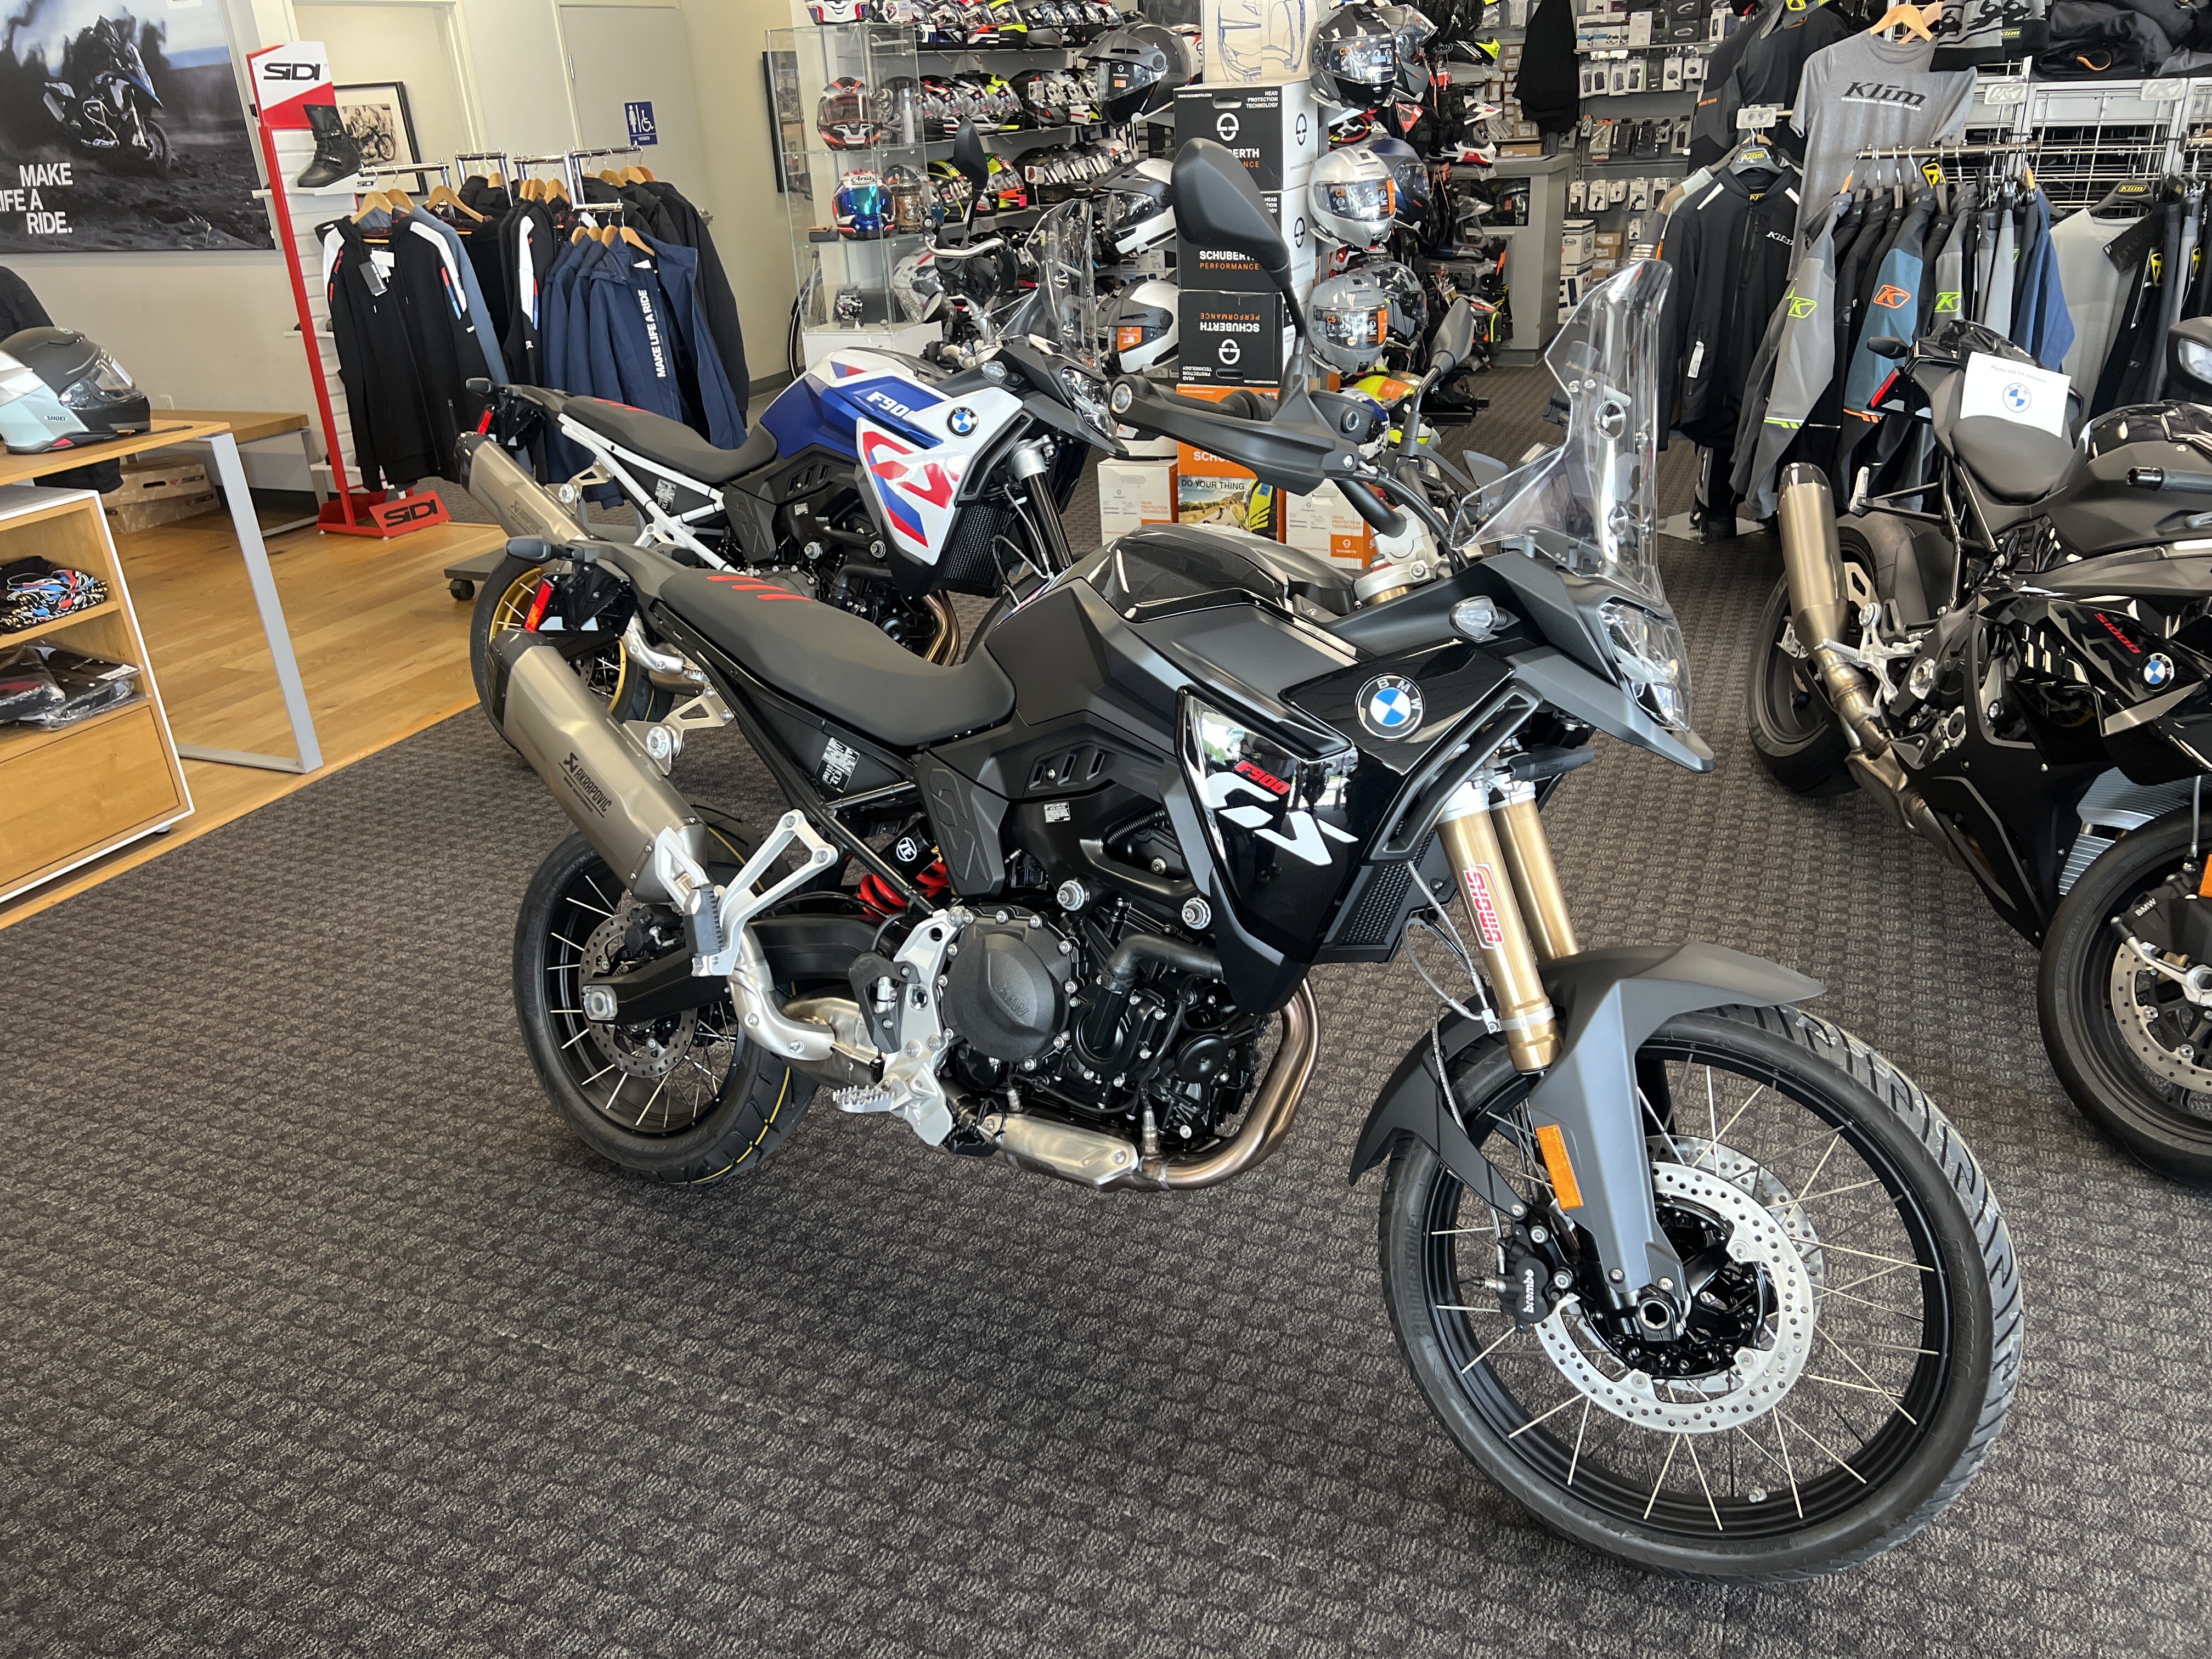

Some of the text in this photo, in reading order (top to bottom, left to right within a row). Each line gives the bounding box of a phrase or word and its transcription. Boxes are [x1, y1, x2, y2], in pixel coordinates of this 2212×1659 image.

[263, 63, 320, 81] SIDI
[19, 162, 74, 187] MAKE
[0, 188, 44, 212] IFE A
[26, 211, 73, 234] RIDE.
[1199, 250, 1255, 261] SCHUBER
[1200, 262, 1259, 270] PERFORMANCE
[1200, 312, 1260, 320] PERFORMANCE
[1200, 321, 1260, 332] SCHUBERTH
[637, 289, 667, 377] MAKE LIFE A RIDE
[1181, 479, 1193, 487] DO
[1195, 480, 1217, 488] YOUR
[1219, 481, 1247, 490] THING.
[384, 499, 438, 528] SIDI
[2094, 613, 2141, 654] S1000
[1234, 759, 1291, 795] F900
[896, 837, 917, 862] ZF
[1464, 870, 1505, 944] SHOWA
[2135, 898, 2157, 917] BMW
[994, 978, 1030, 1017] BMW
[1523, 1268, 1534, 1314] brembo
